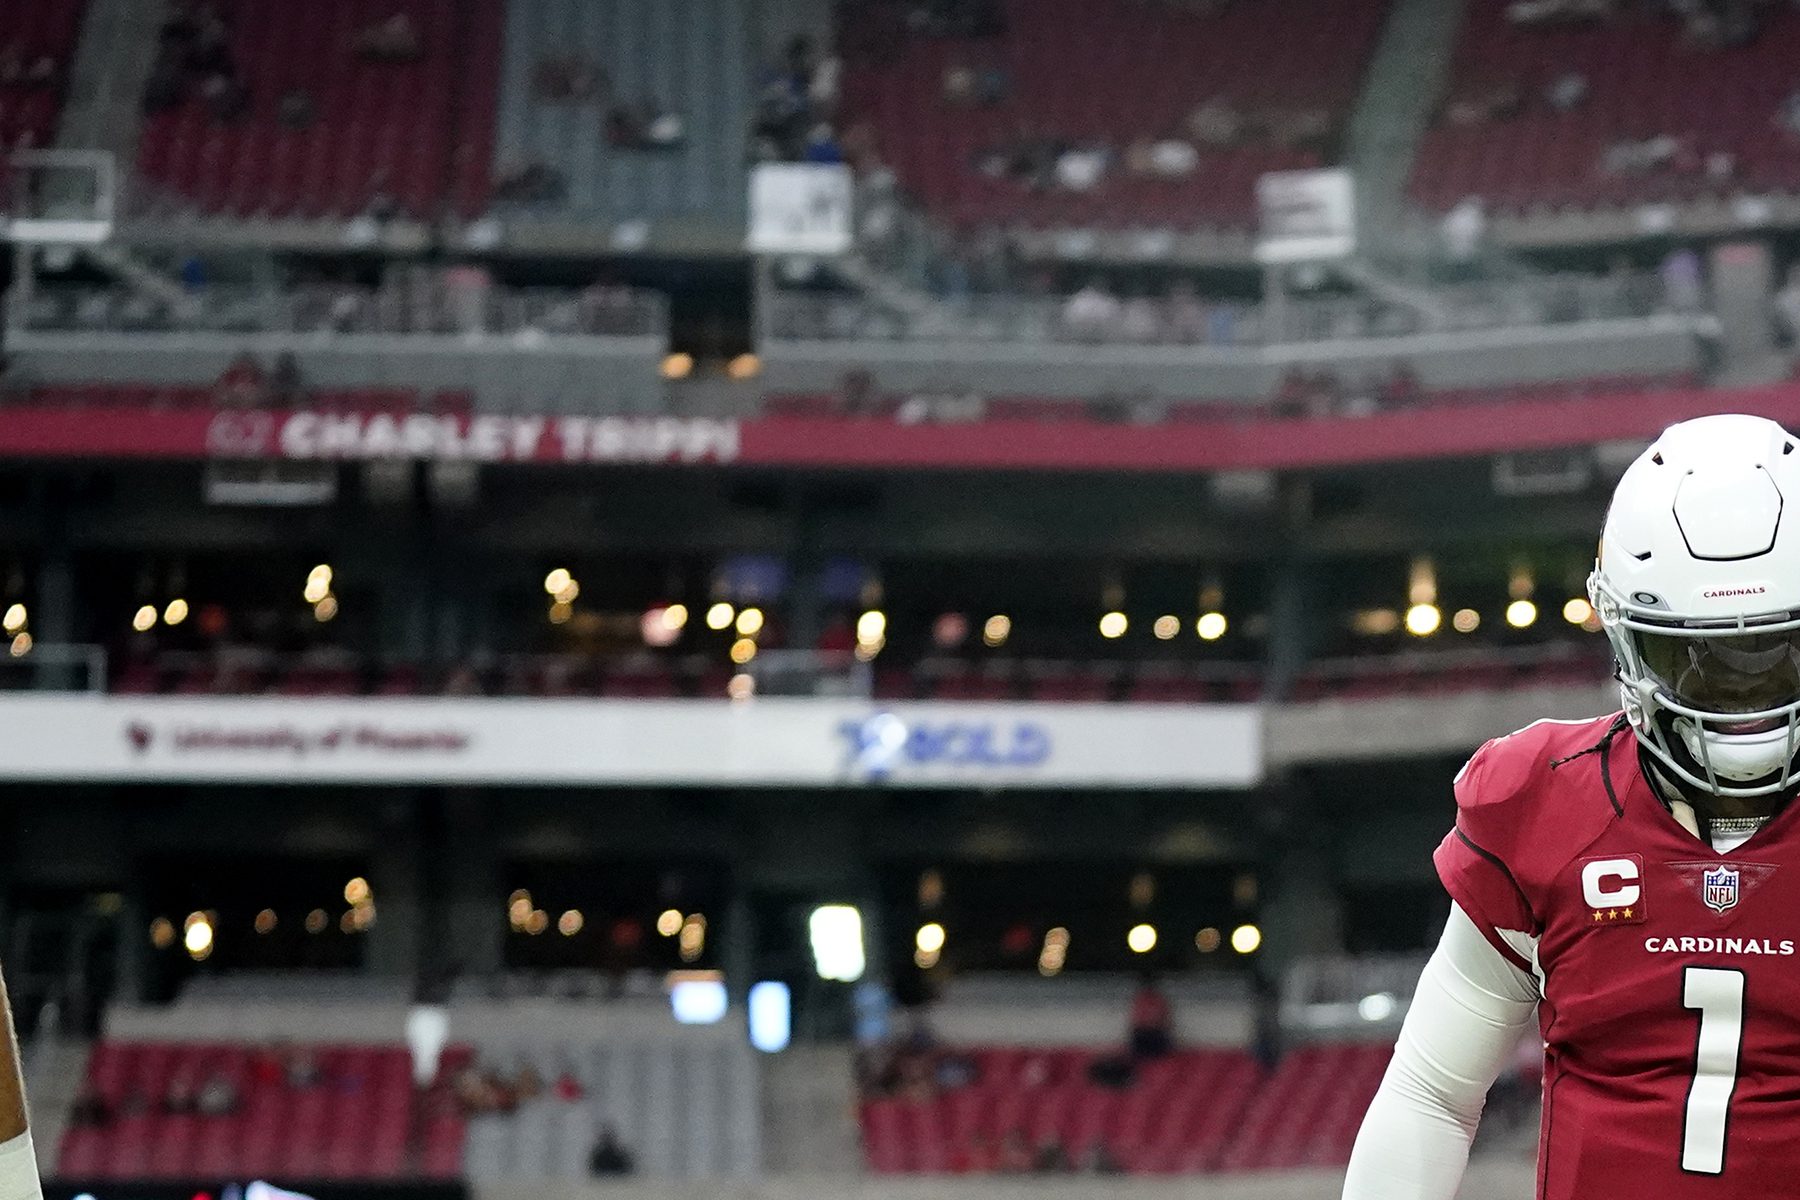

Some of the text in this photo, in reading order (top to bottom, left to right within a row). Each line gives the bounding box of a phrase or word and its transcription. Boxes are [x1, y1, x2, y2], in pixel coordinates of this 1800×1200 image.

[280, 411, 543, 461] CHARLEY
[559, 416, 740, 463] TRIPPI
[1703, 586, 1766, 599] CARDINALS
[173, 722, 308, 758] University
[319, 725, 347, 752] of
[1581, 859, 1641, 909] C
[1708, 886, 1733, 904] NFL
[1644, 937, 1795, 955] CARDINALS
[1681, 966, 1745, 1176] 1
